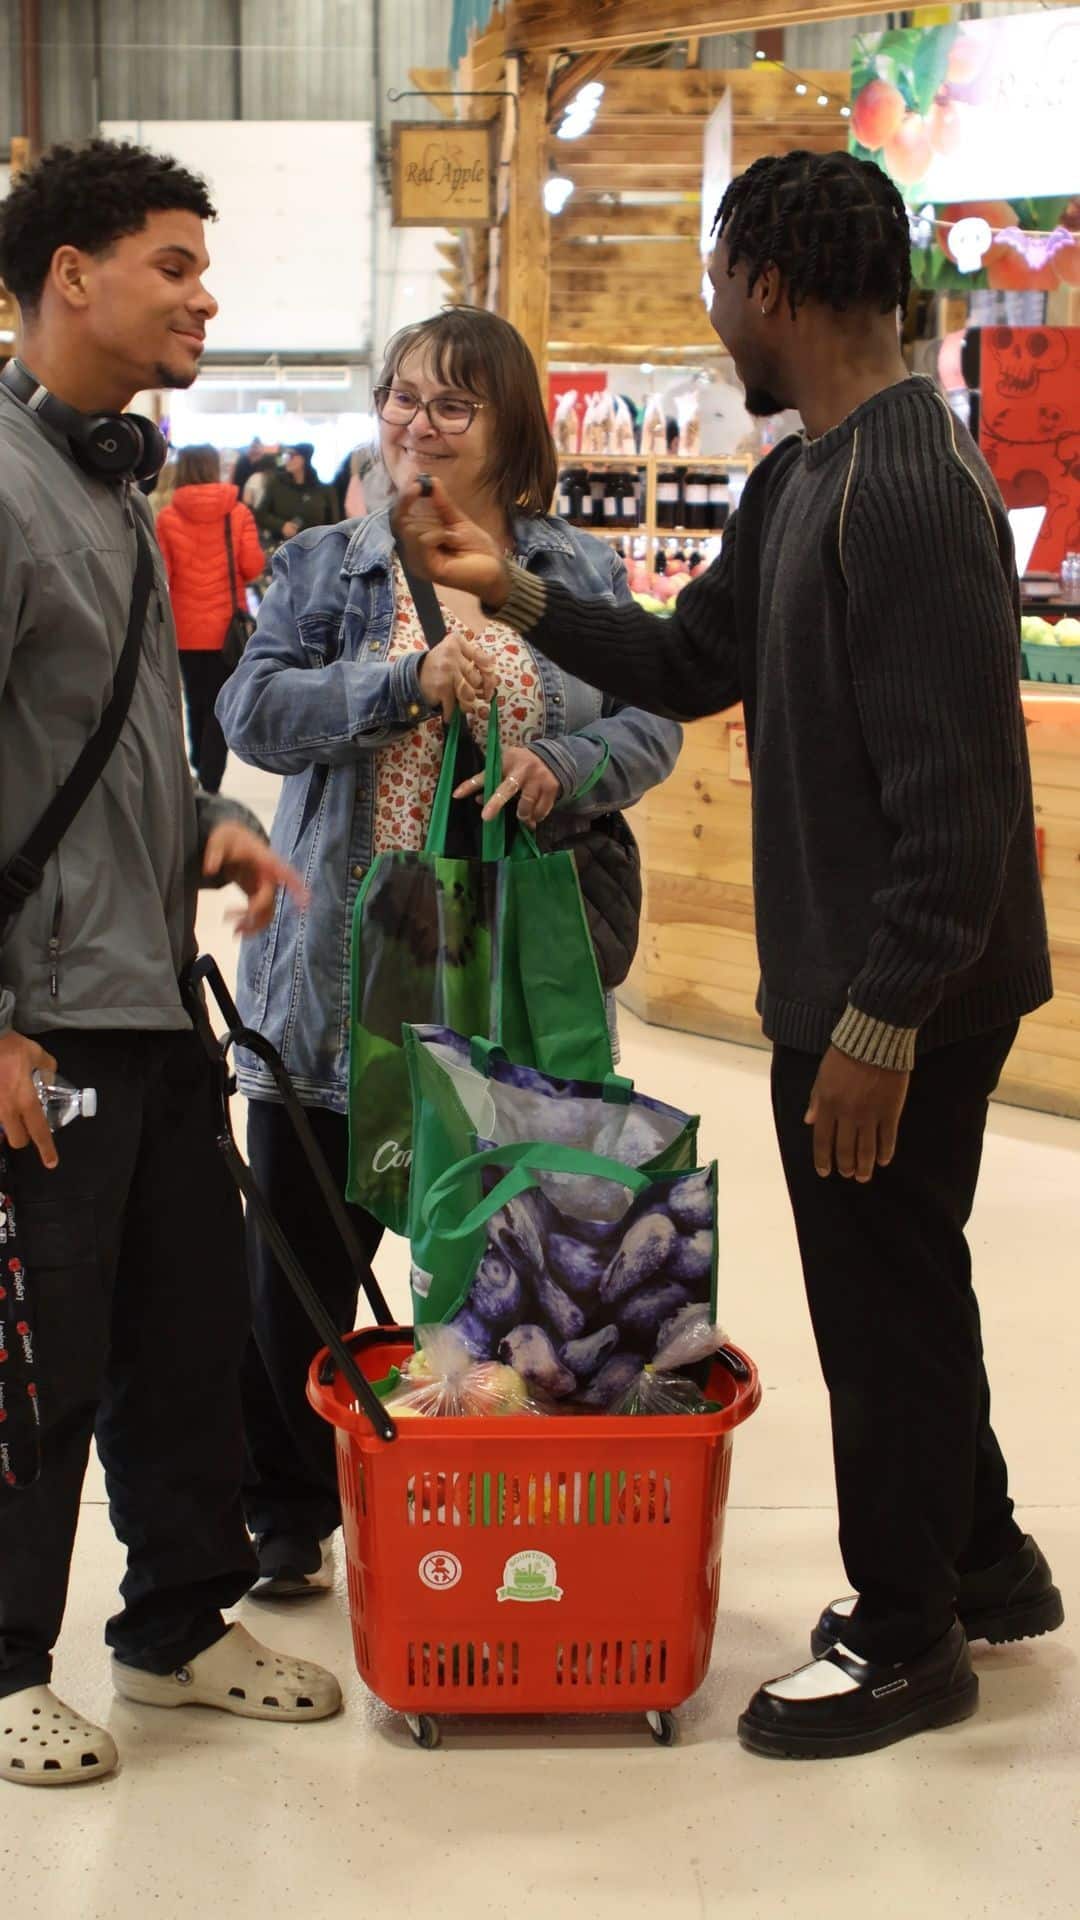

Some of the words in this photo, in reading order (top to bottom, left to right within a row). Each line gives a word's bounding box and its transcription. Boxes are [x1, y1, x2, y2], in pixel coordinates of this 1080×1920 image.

[406, 160, 436, 186] Red
[437, 157, 485, 190] Apple
[14, 1272, 25, 1301] Legion
[22, 1335, 33, 1363] Legion
